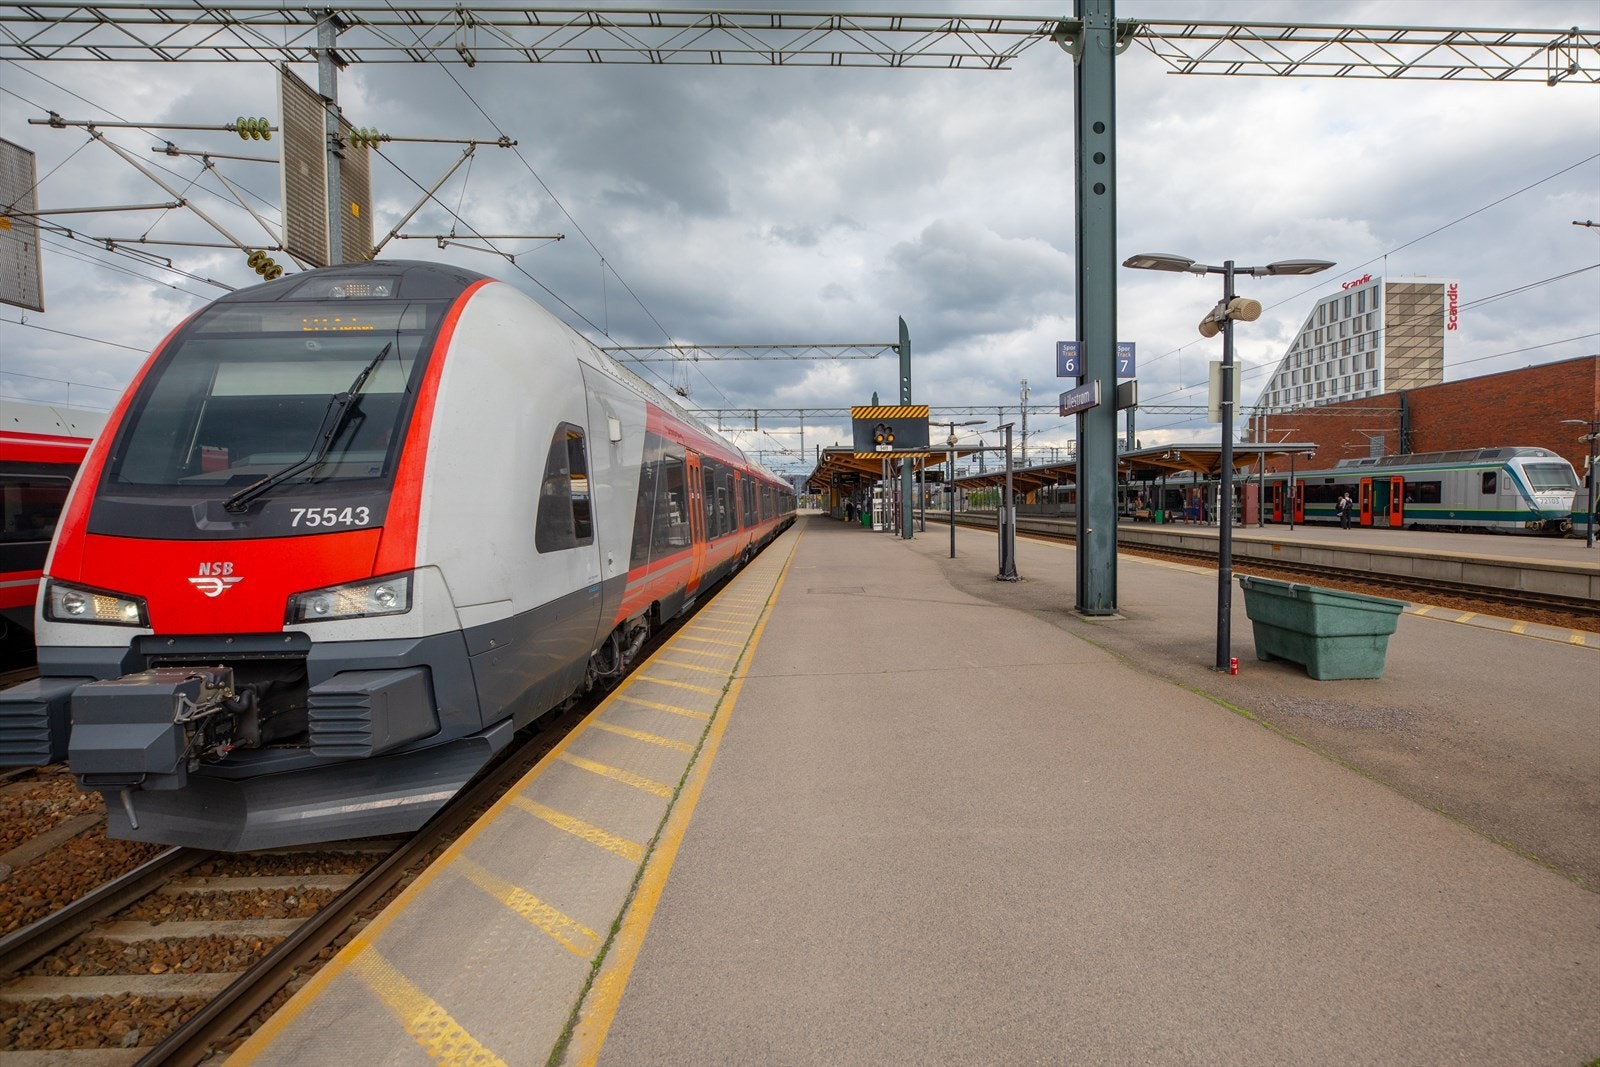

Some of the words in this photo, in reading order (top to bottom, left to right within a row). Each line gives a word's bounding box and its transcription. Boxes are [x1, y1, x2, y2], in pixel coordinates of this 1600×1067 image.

[1447, 283, 1458, 331] Scandic
[1065, 359, 1074, 372] 6
[1120, 360, 1128, 372] 7
[290, 506, 370, 527] 75543
[198, 561, 234, 576] NSB
